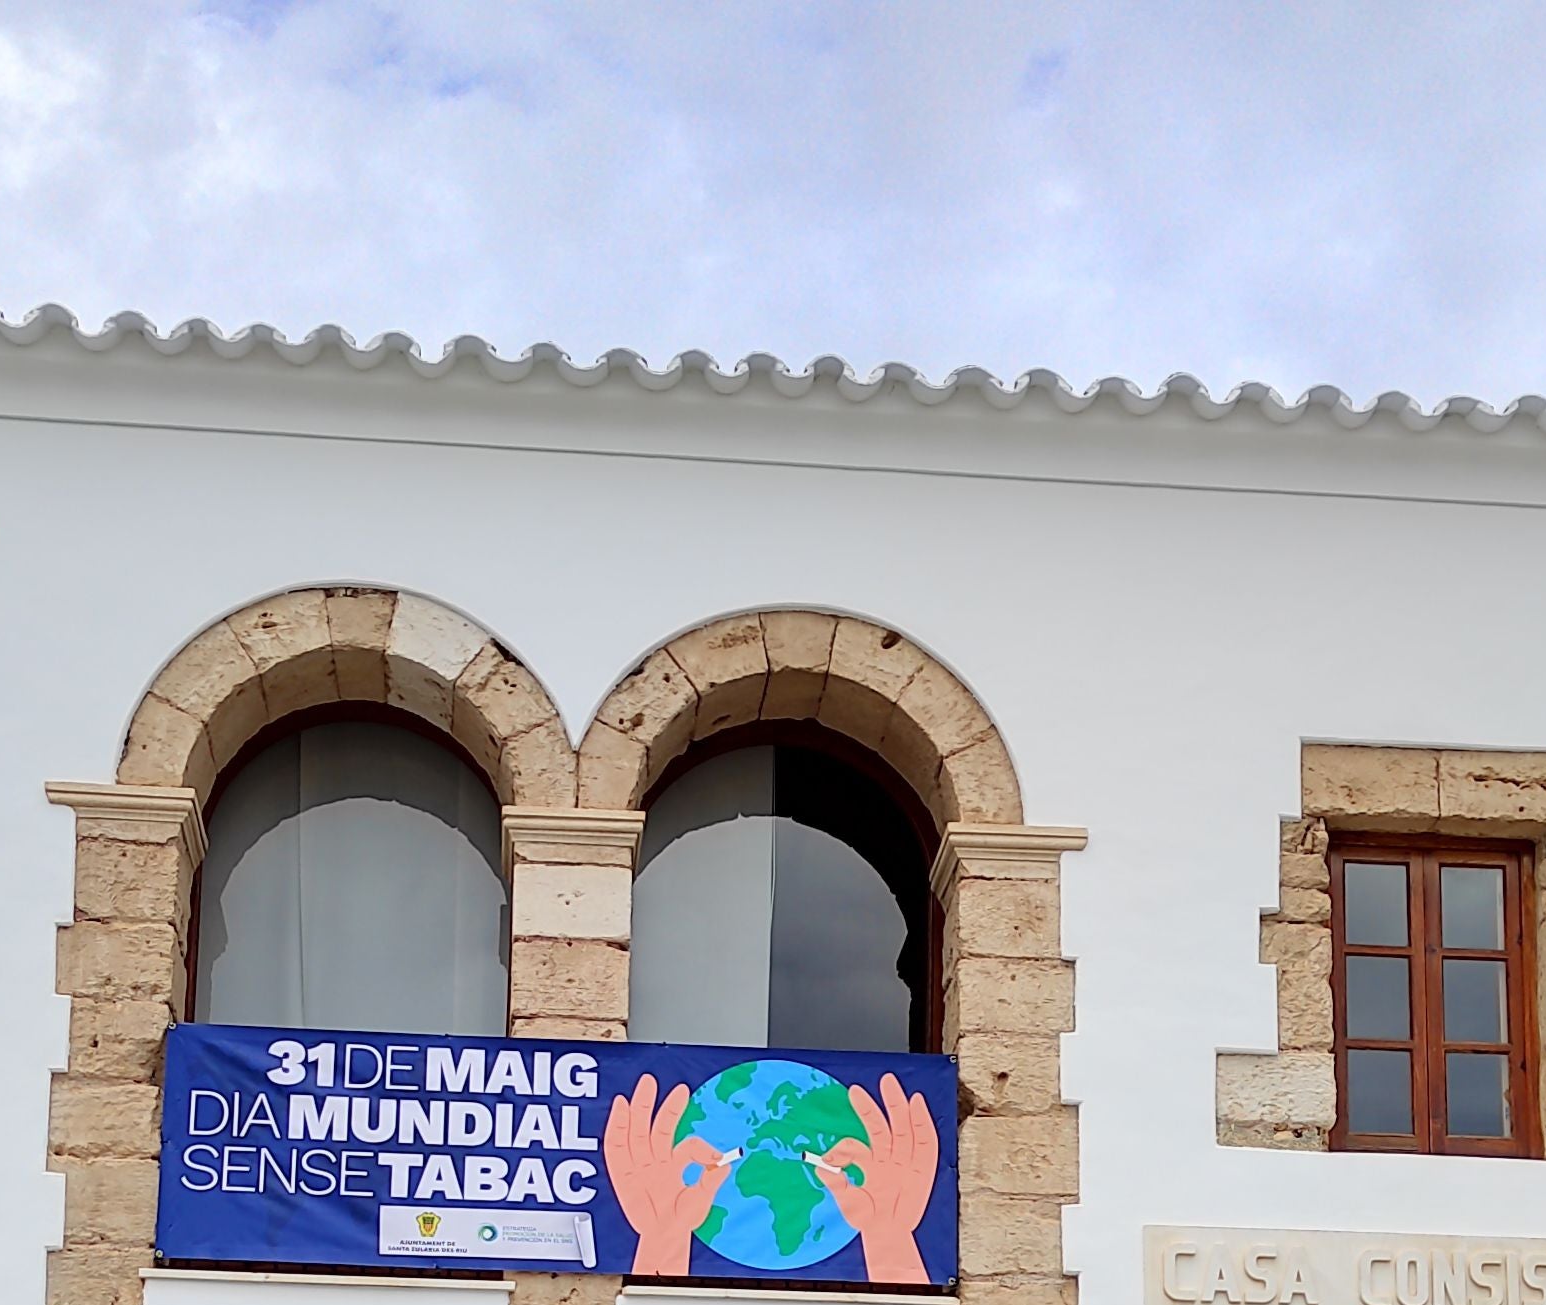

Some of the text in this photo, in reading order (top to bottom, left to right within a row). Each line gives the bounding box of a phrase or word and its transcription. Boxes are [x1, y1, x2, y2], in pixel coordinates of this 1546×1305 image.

[266, 1040, 599, 1098] 31 DE MAIG
[189, 1089, 599, 1151] DIA MUNDIAL
[181, 1144, 598, 1205] SENSE TABAC
[399, 1239, 446, 1247] AJUNTAMENT
